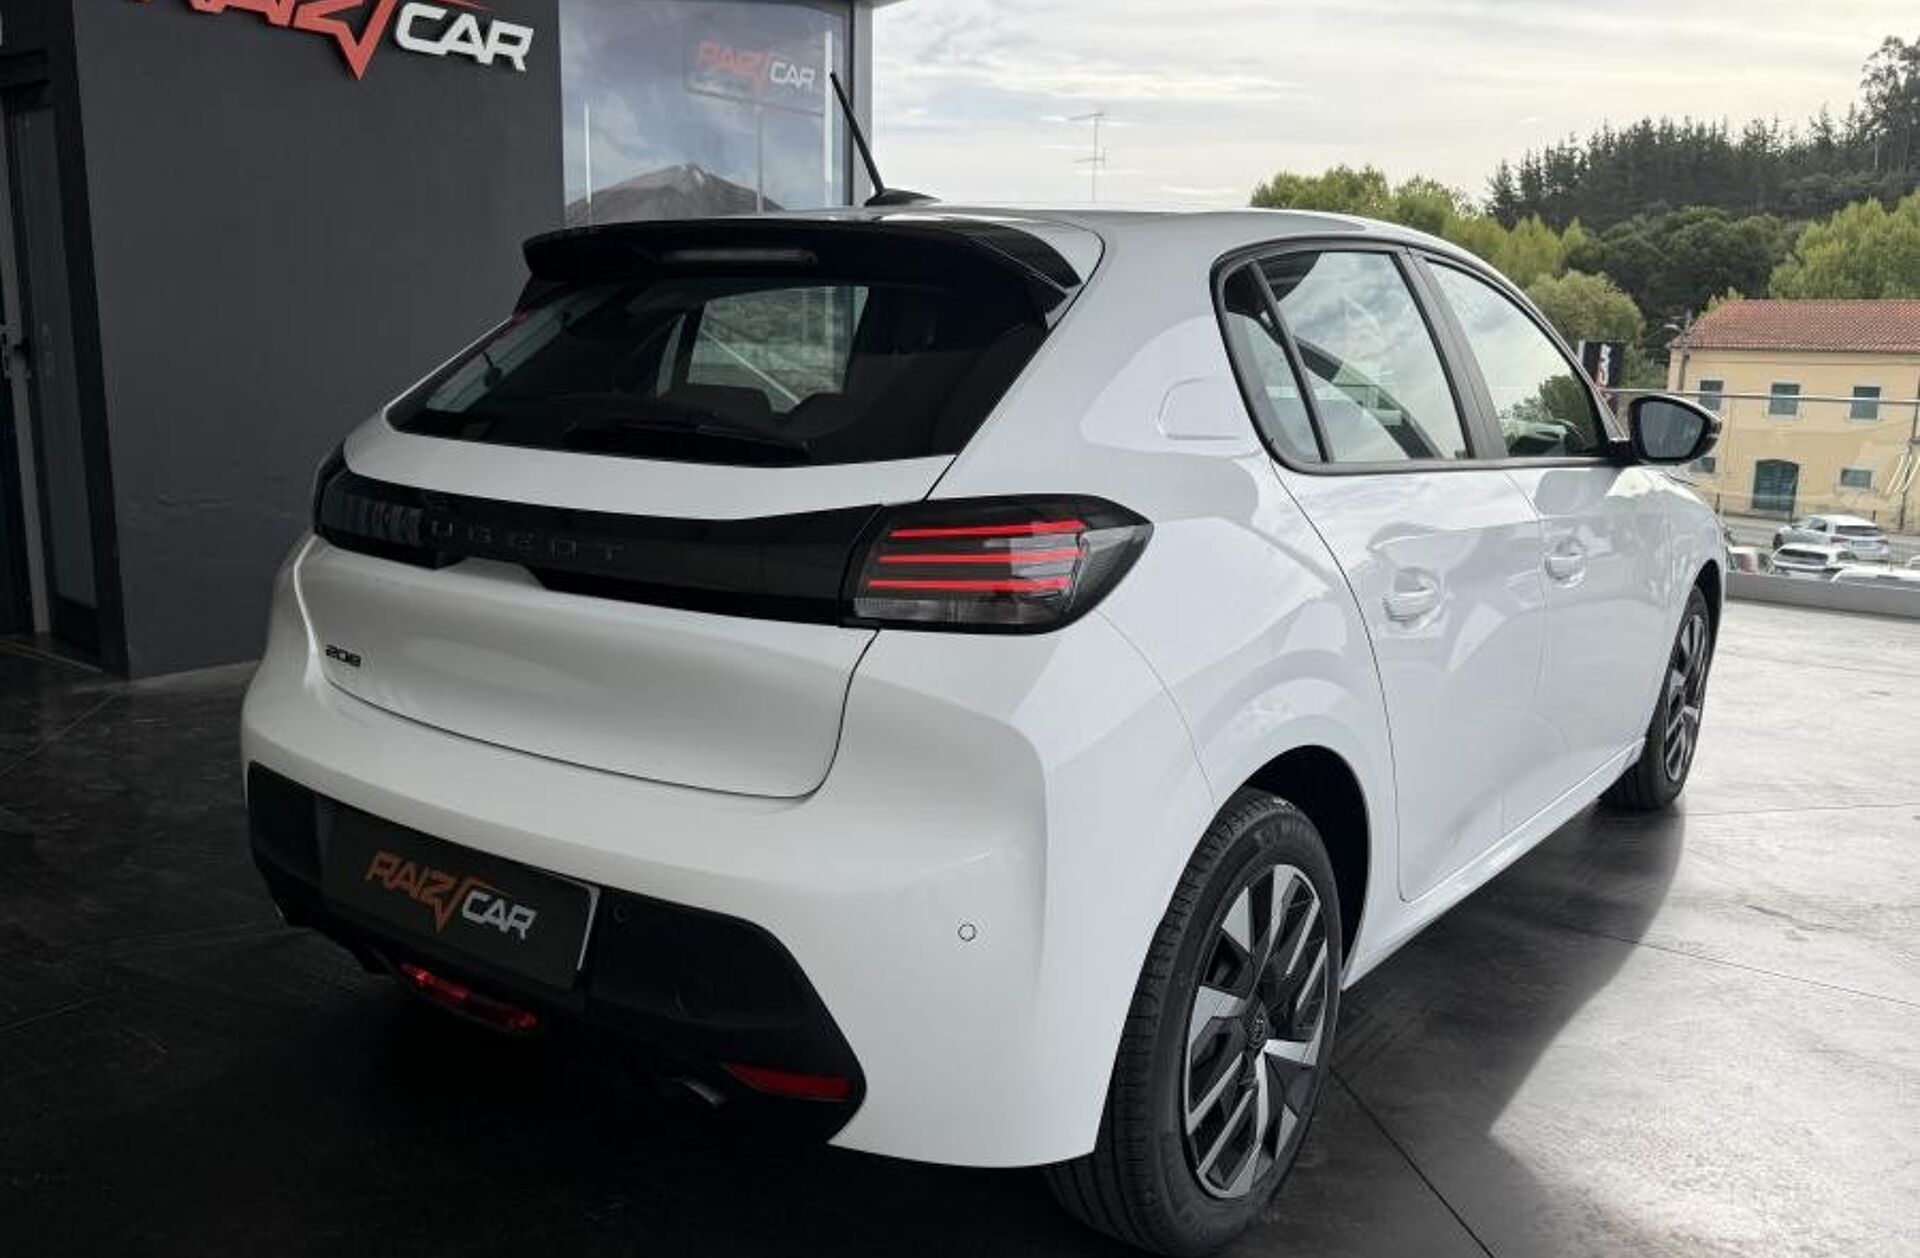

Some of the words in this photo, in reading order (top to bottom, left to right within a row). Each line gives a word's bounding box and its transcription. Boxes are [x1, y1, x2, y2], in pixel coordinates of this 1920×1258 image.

[394, 2, 535, 72] CAR
[769, 60, 816, 91] CAR
[325, 644, 362, 668] 208
[461, 889, 538, 940] CAR
